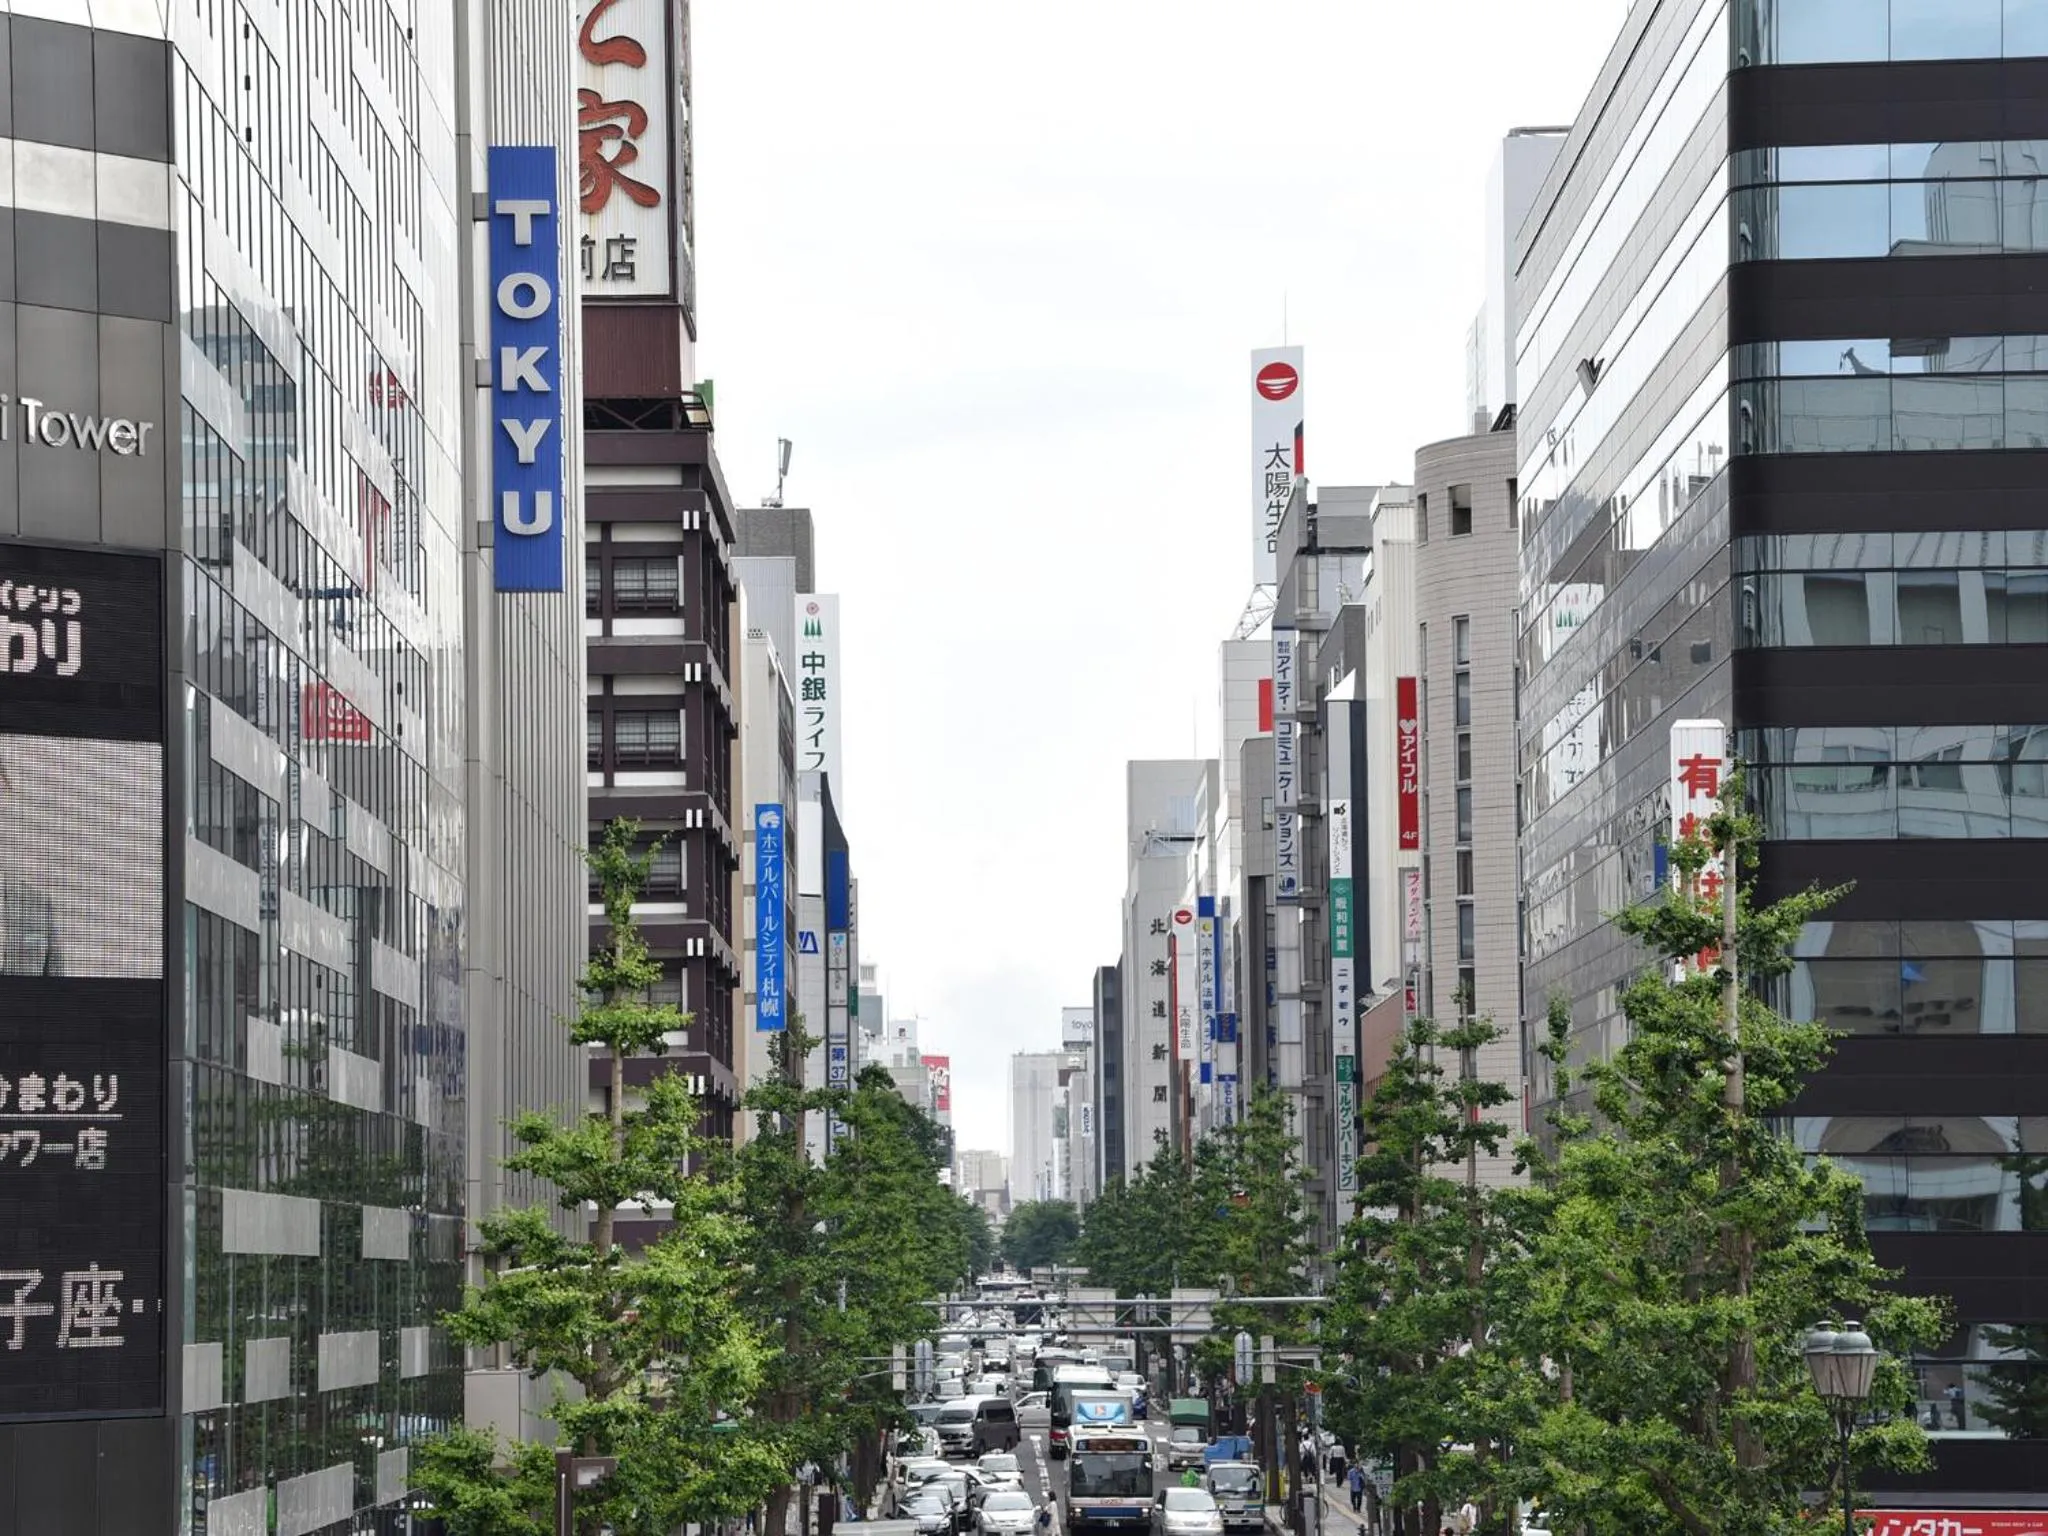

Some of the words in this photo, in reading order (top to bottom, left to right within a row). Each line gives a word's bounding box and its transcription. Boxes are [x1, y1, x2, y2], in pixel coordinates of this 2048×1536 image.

[495, 200, 553, 535] TOKYU
[20, 397, 153, 456] Tower
[801, 650, 827, 771] 中銀ライフ
[1400, 735, 1418, 795] アイフル
[1402, 830, 1418, 840] 4F
[760, 833, 780, 1017] ホテルパールシティ札幌
